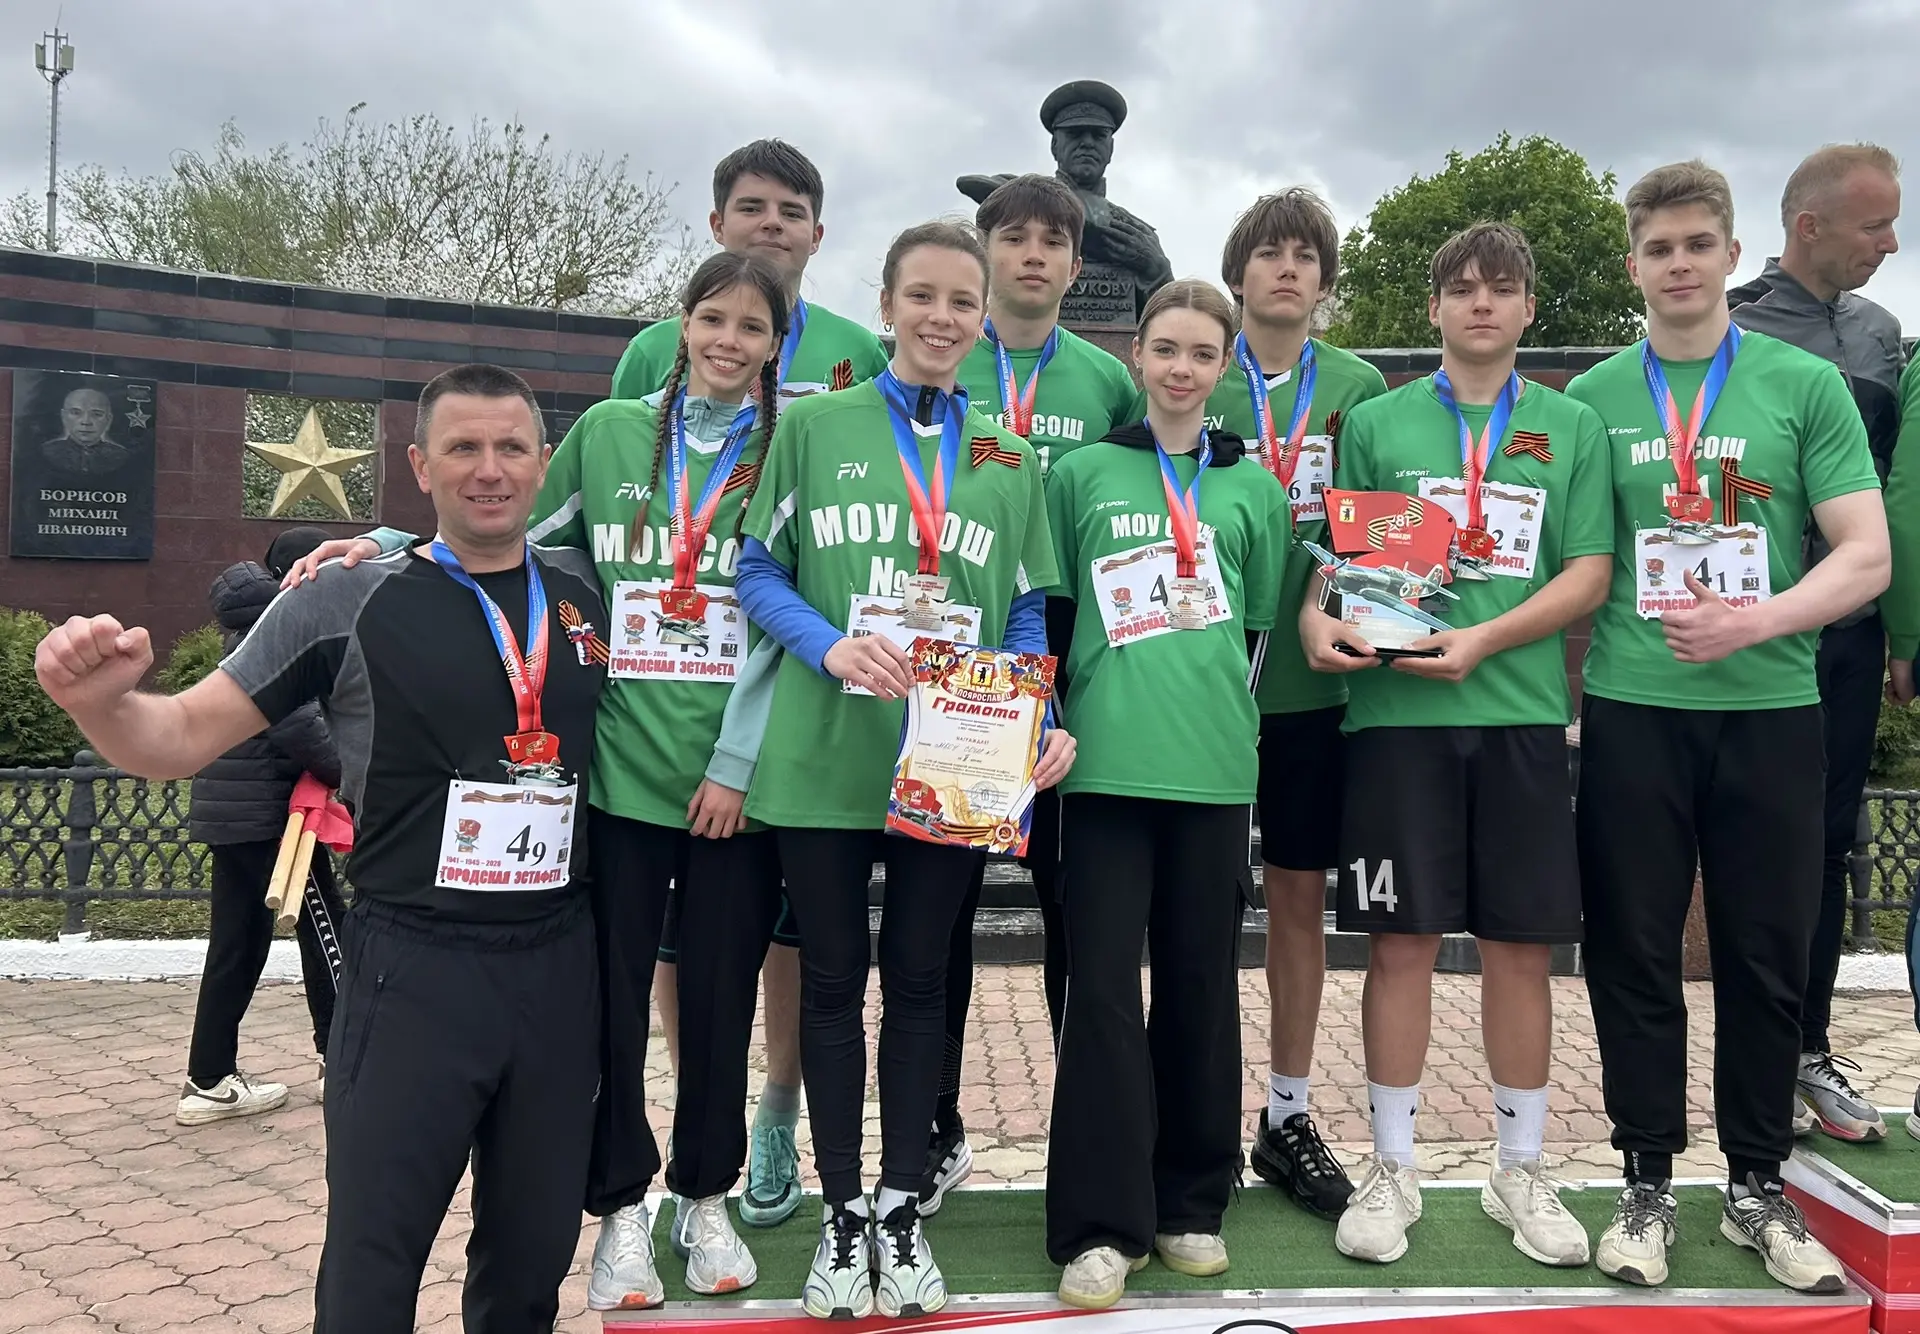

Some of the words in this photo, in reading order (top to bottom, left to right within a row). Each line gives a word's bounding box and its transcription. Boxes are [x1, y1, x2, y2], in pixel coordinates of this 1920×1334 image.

[1031, 413, 1084, 442] СОШ
[837, 462, 869, 480] FN
[40, 489, 127, 504] БОРИСОВ
[47, 508, 118, 520] МИХАИЛ
[37, 523, 127, 537] ИВАНОВИЧ
[810, 502, 898, 549] МОУ
[1110, 512, 1161, 540] МОУ
[611, 657, 675, 674] ГОРОДСКАЯ
[680, 660, 735, 676] ЭСТАФЕТА
[932, 697, 1021, 720] Грамота
[440, 865, 511, 886] ГОРОДСКАЯ
[514, 868, 561, 885] ЭСТАФЕТА
[1349, 857, 1398, 913] 14
